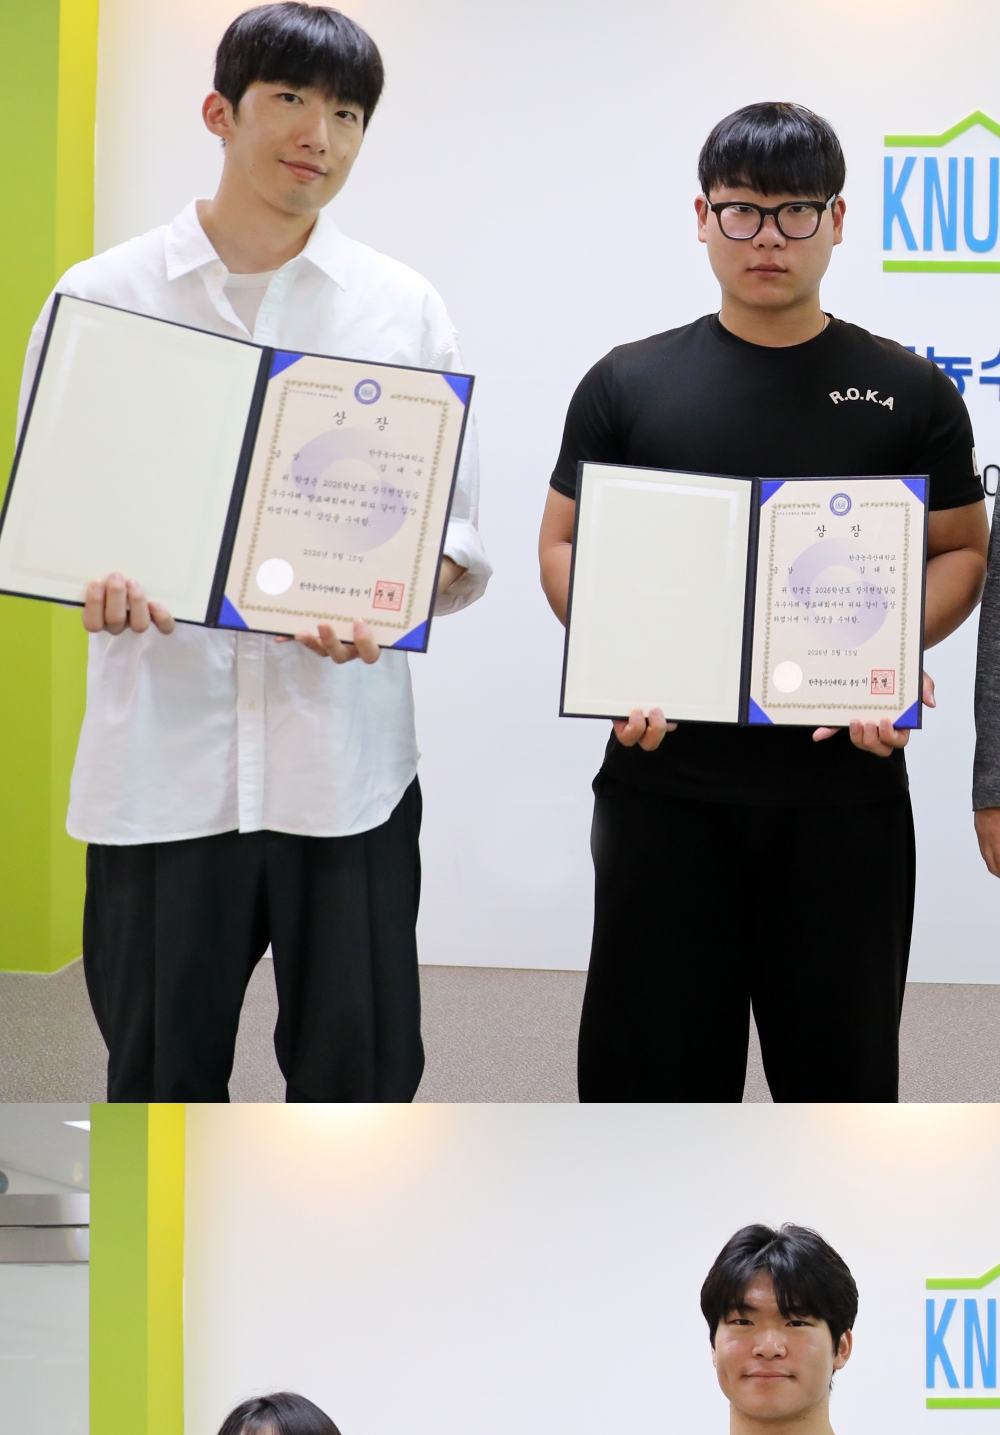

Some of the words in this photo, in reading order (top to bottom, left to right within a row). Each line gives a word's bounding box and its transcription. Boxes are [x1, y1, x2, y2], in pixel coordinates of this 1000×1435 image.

[829, 387, 895, 410] R.O.K.A
[333, 411, 346, 425] 상
[374, 417, 388, 430] 장
[815, 525, 826, 538] 상
[850, 524, 861, 538] 장
